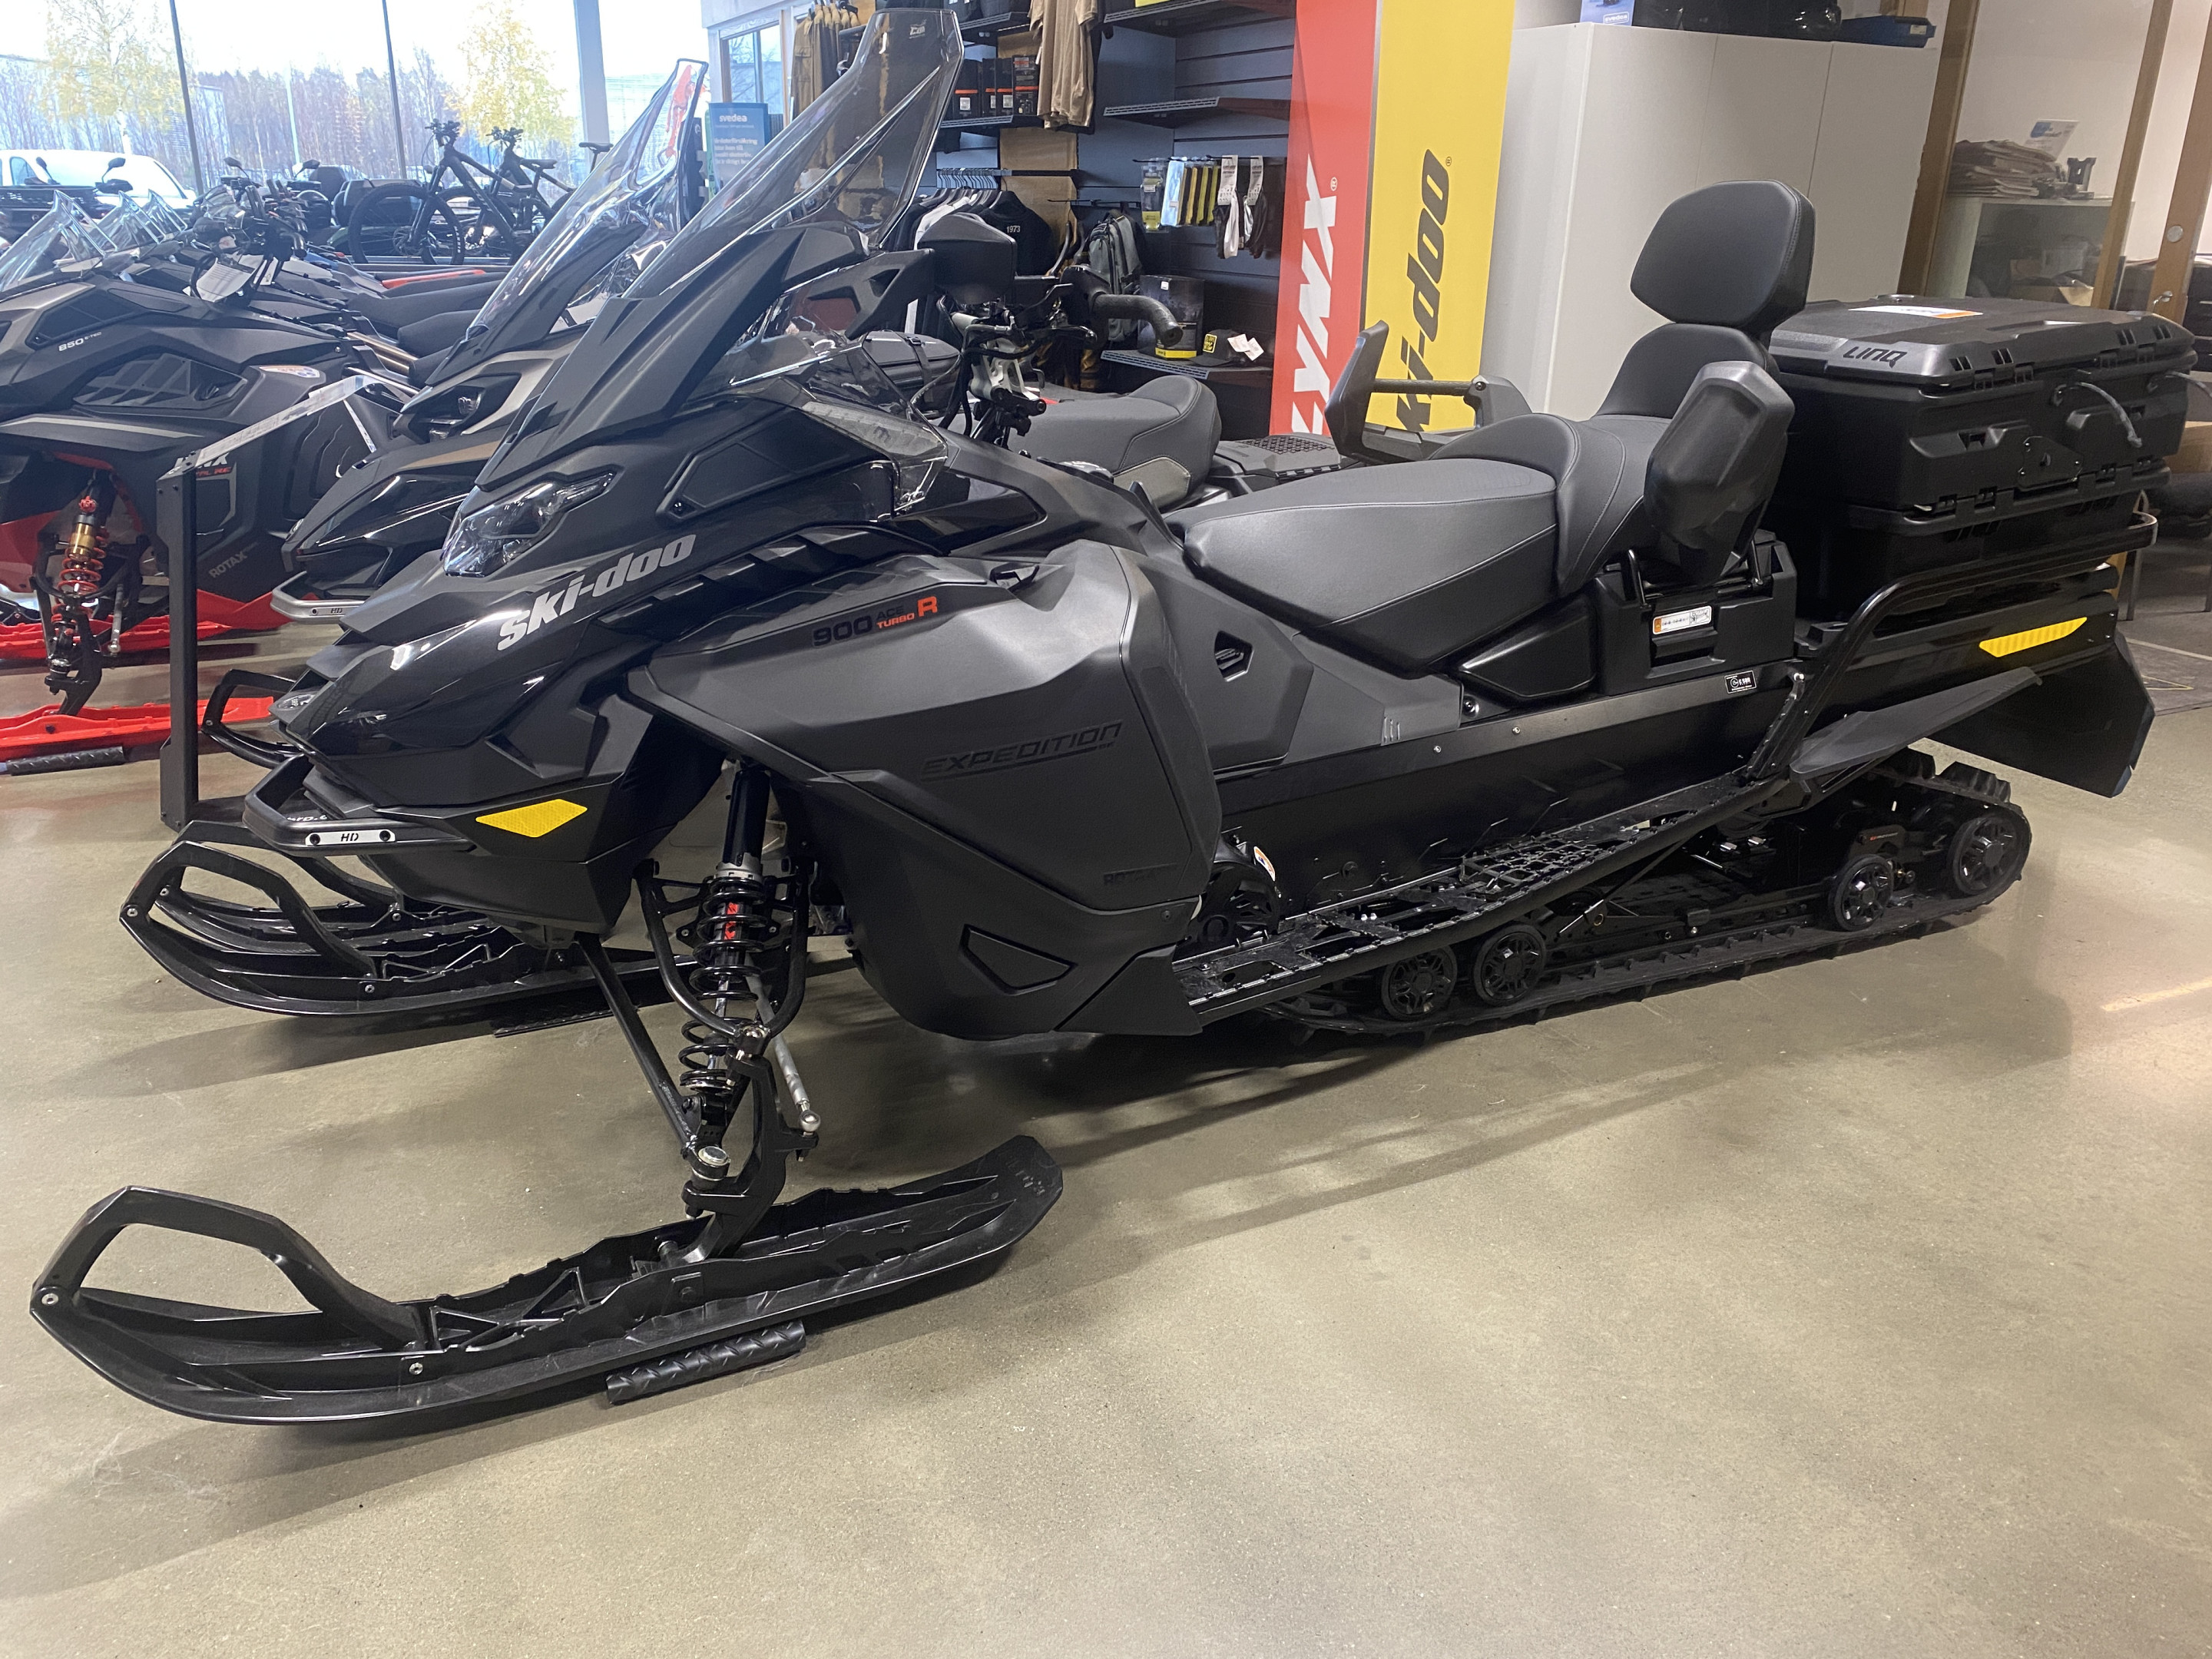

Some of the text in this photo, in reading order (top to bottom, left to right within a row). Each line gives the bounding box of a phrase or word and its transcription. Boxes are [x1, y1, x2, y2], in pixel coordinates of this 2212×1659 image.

[719, 114, 747, 122] svedea
[1006, 225, 1021, 233] 1973
[58, 338, 84, 351] 850
[208, 551, 247, 578] ROTAX
[876, 596, 938, 629] TURBO R
[813, 605, 905, 647] 900 ACE
[923, 722, 1123, 774] EXPEDITION
[341, 833, 359, 842] HD
